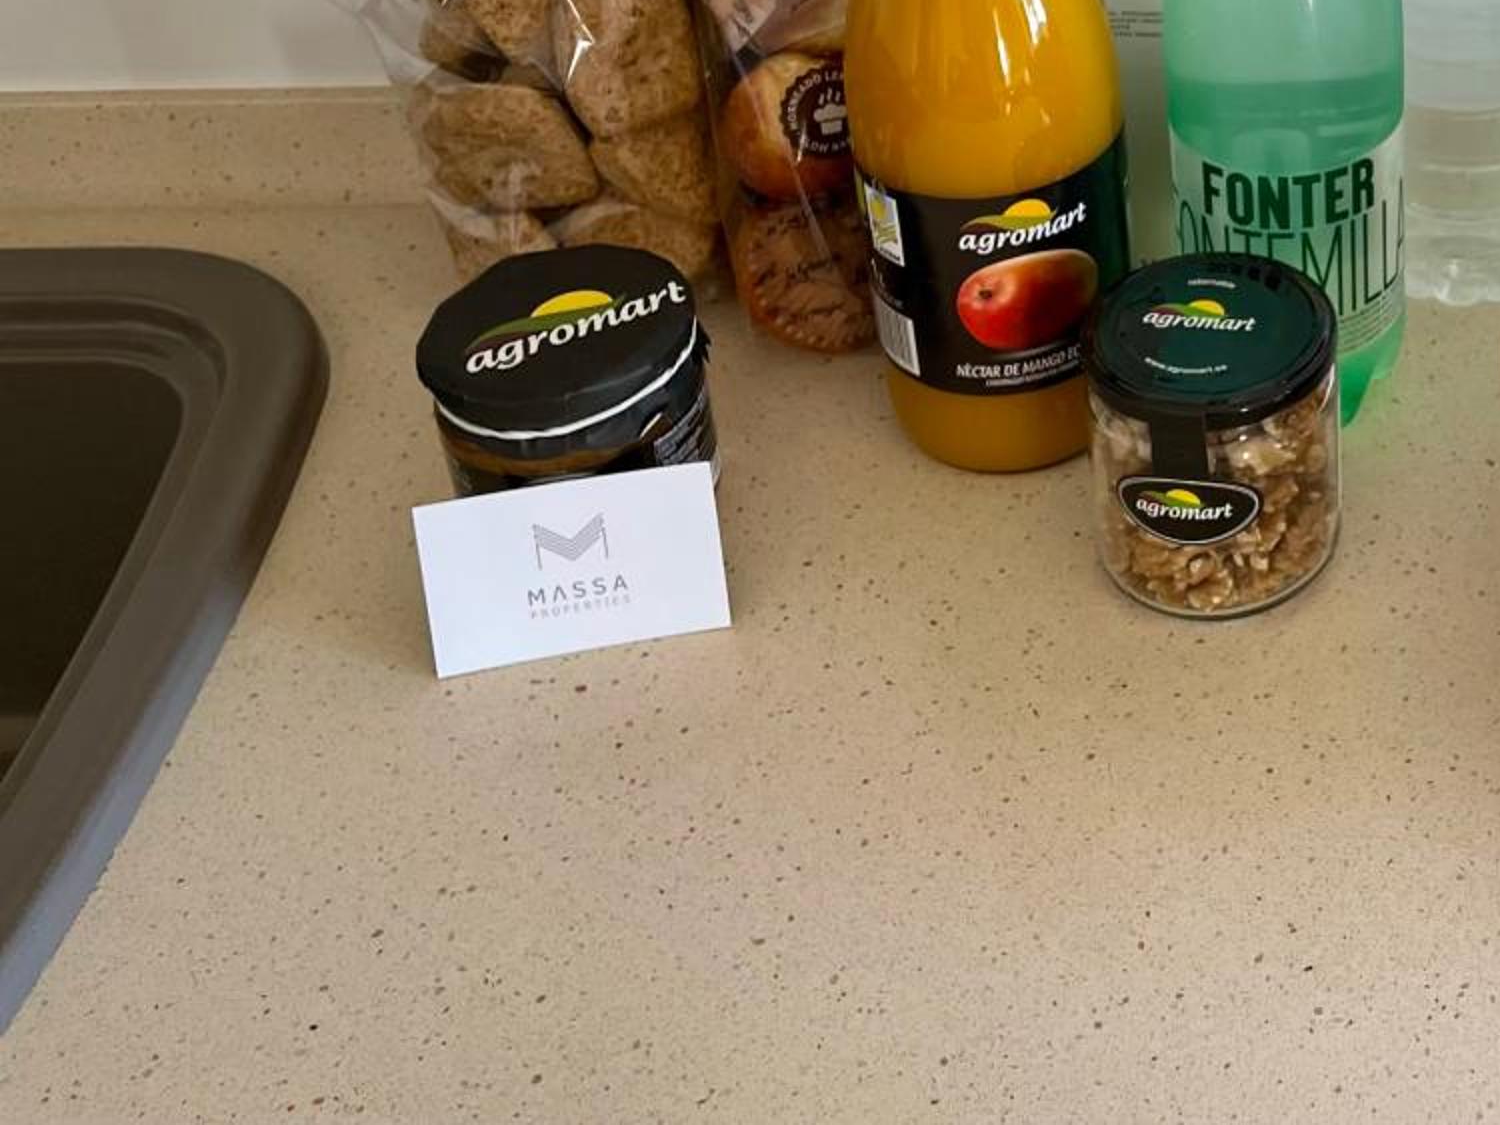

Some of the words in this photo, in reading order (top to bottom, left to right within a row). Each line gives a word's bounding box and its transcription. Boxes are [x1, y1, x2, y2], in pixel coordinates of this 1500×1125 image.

[1202, 157, 1375, 231] FONTER
[958, 202, 1087, 255] agromart
[465, 280, 687, 374] agromart
[1142, 311, 1257, 332] agromart
[1003, 362, 1021, 377] DE
[1022, 350, 1066, 375] MANGO
[1135, 496, 1234, 522] agromart
[527, 573, 629, 607] MASSA
